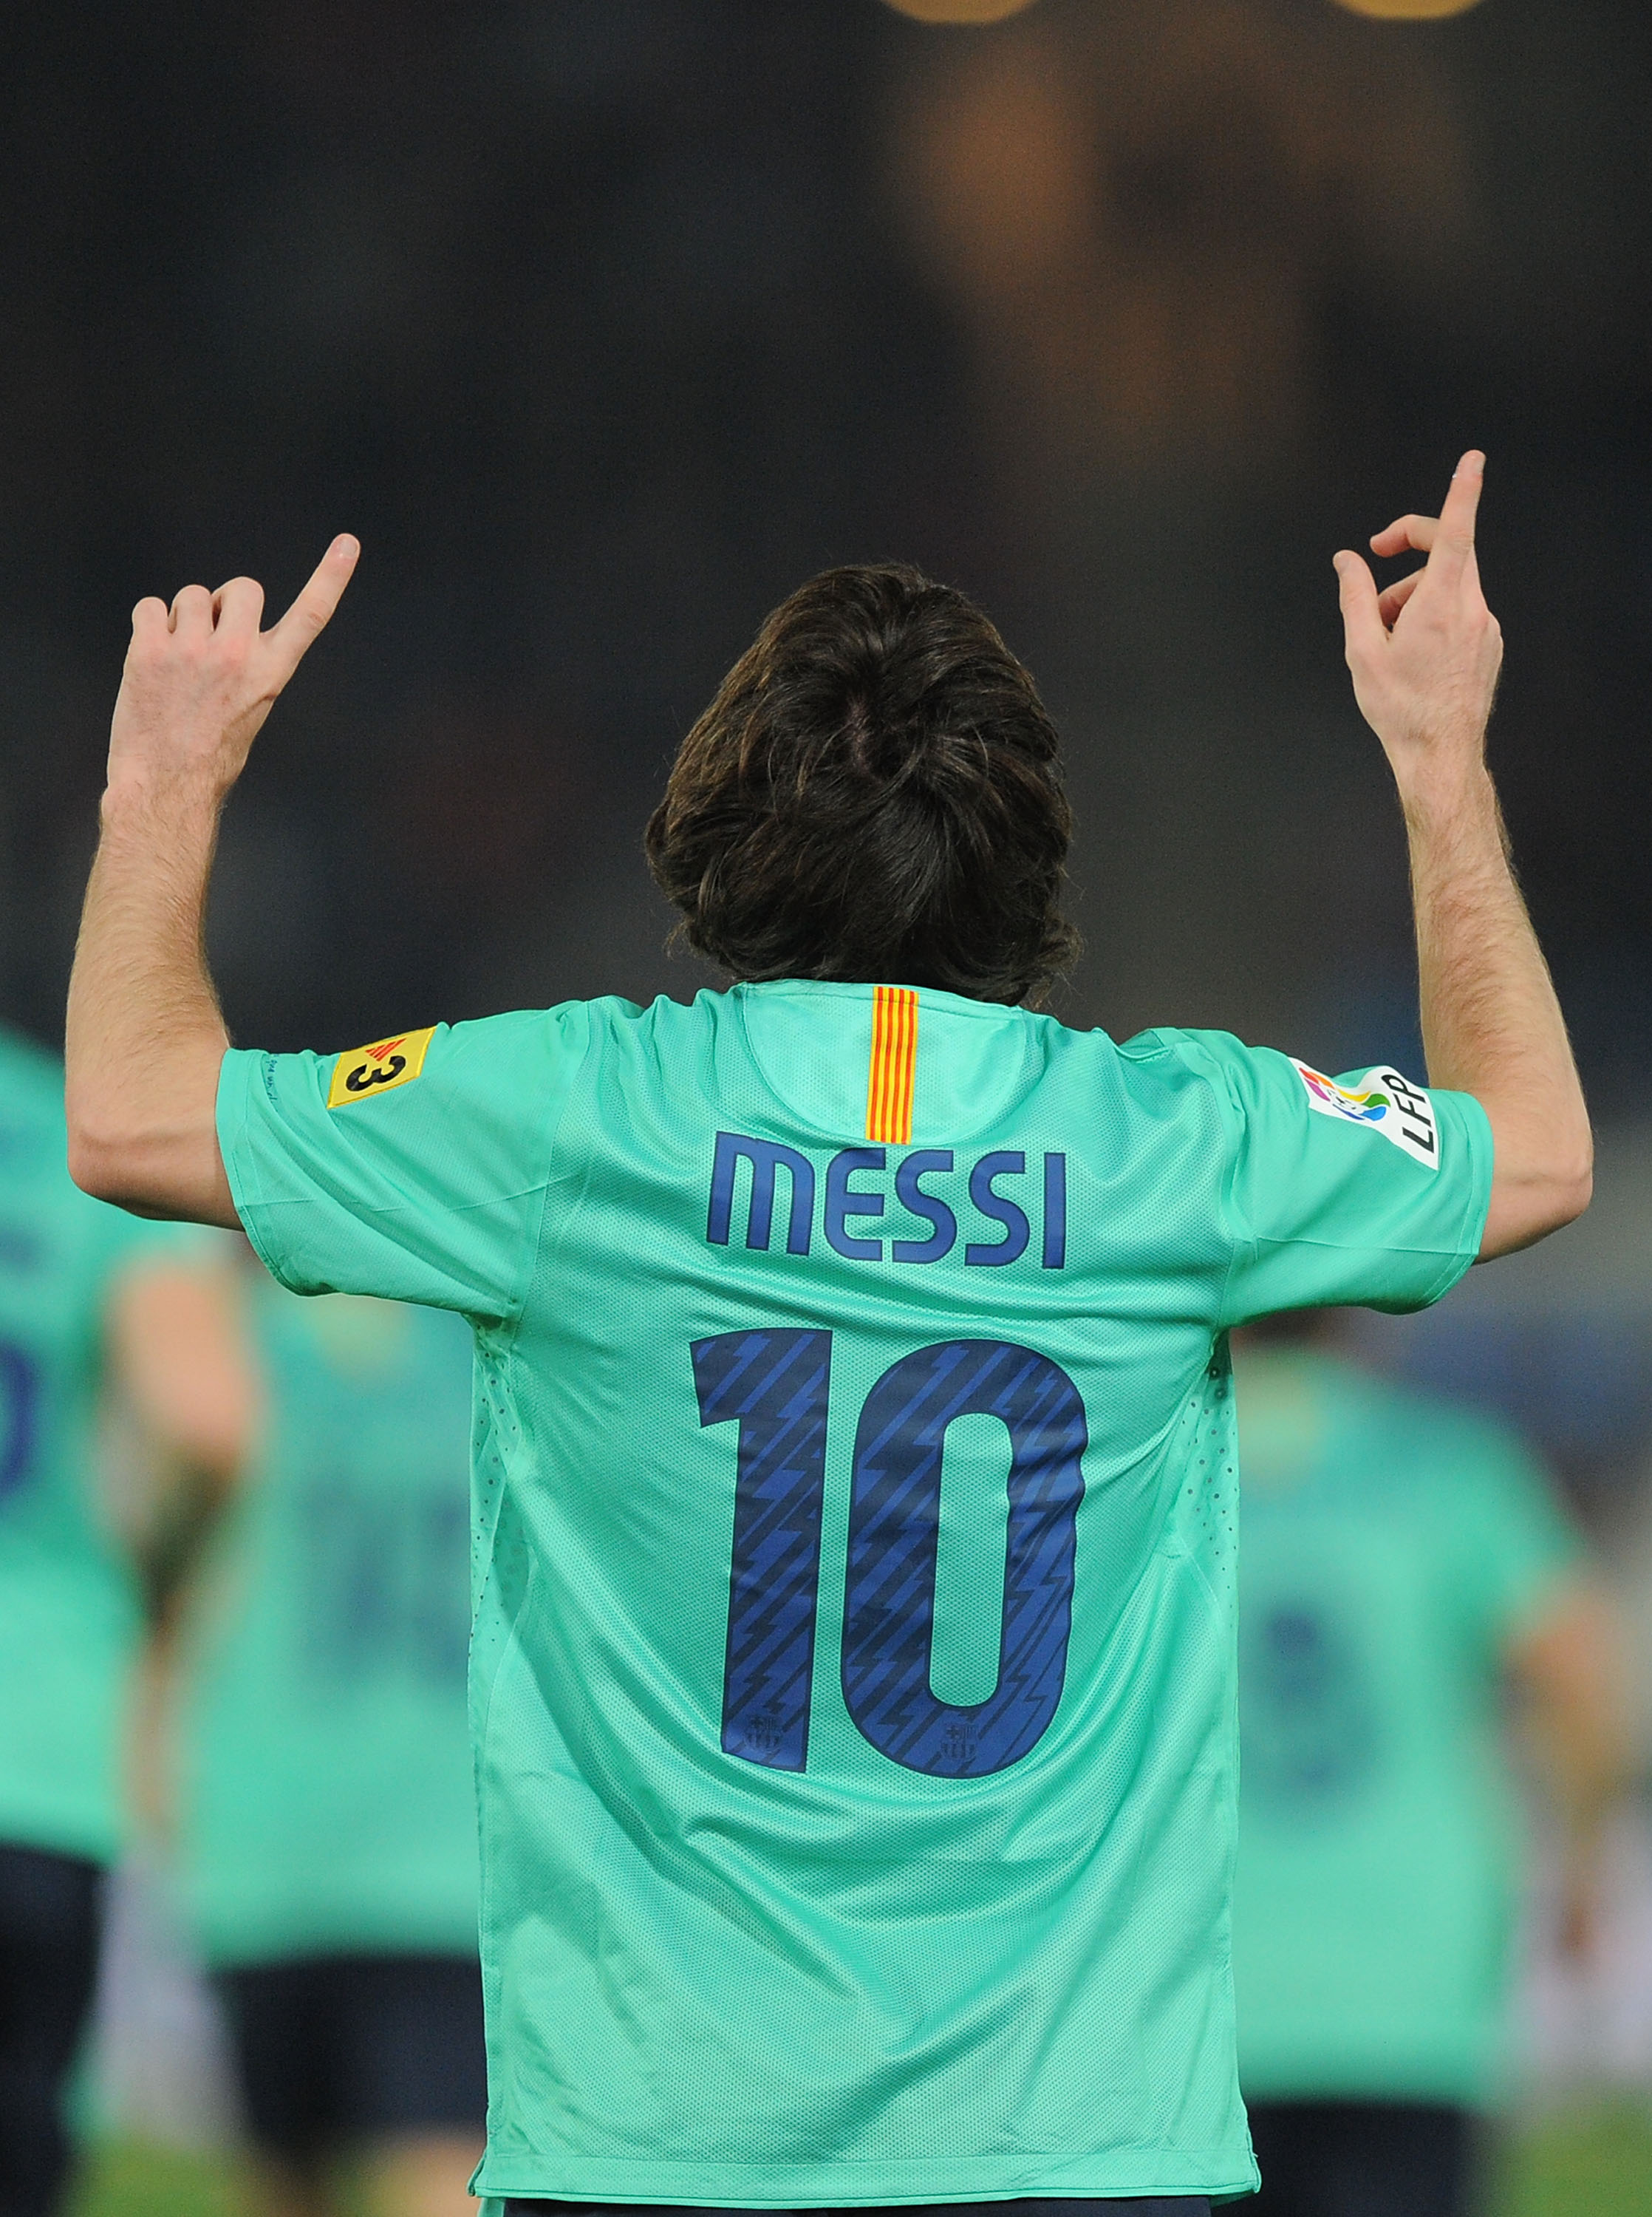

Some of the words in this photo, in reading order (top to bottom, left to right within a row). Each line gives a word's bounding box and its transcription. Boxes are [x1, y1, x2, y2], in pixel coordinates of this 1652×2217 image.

[346, 1055, 406, 1092] 3
[1381, 1075, 1434, 1153] LFP
[706, 1131, 1065, 1269] MESSI
[689, 1327, 1089, 1779] 10
